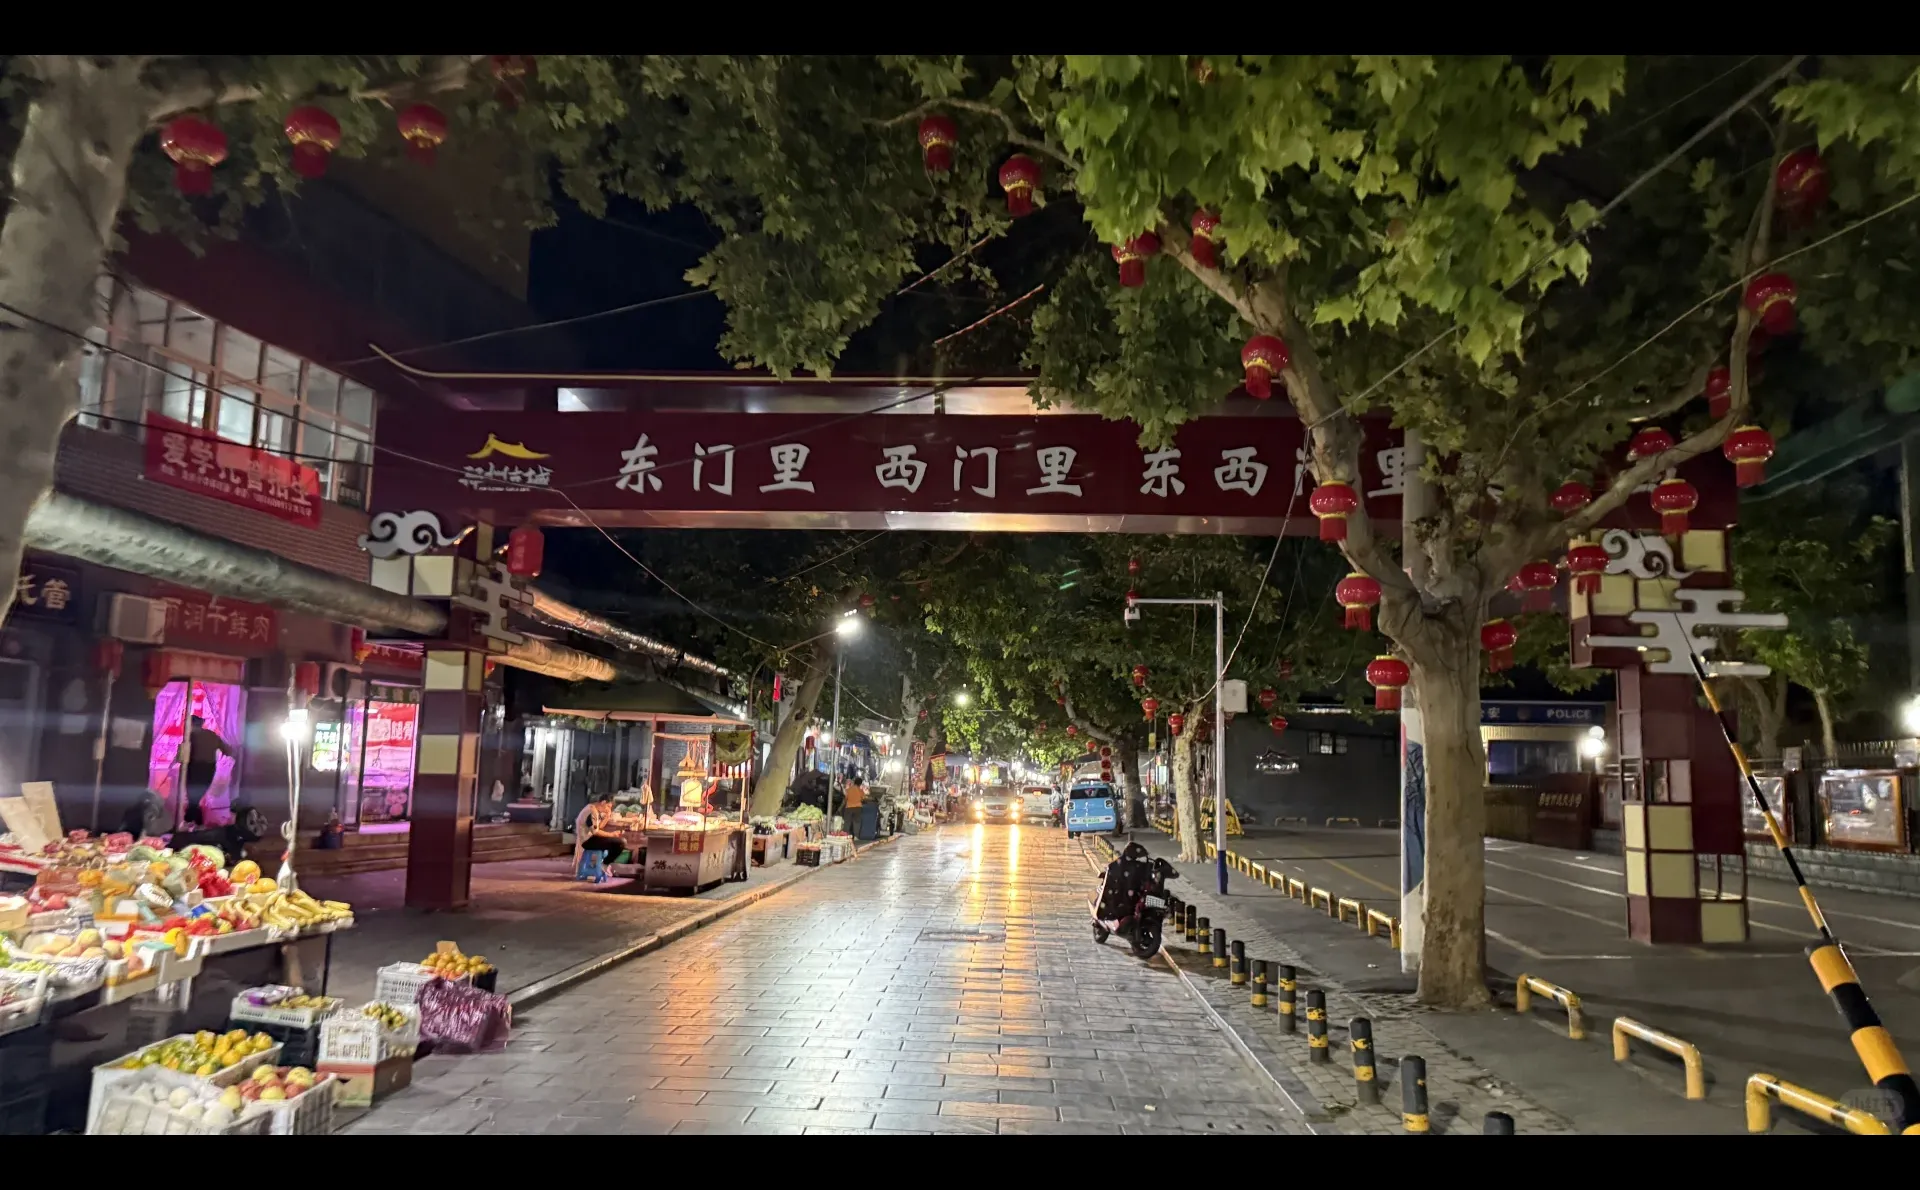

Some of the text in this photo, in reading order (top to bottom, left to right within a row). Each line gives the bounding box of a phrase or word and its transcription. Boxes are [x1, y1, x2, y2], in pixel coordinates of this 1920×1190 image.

[615, 433, 1405, 498] 东门里 西门里 东西里
[1546, 708, 1592, 719] POLICE
